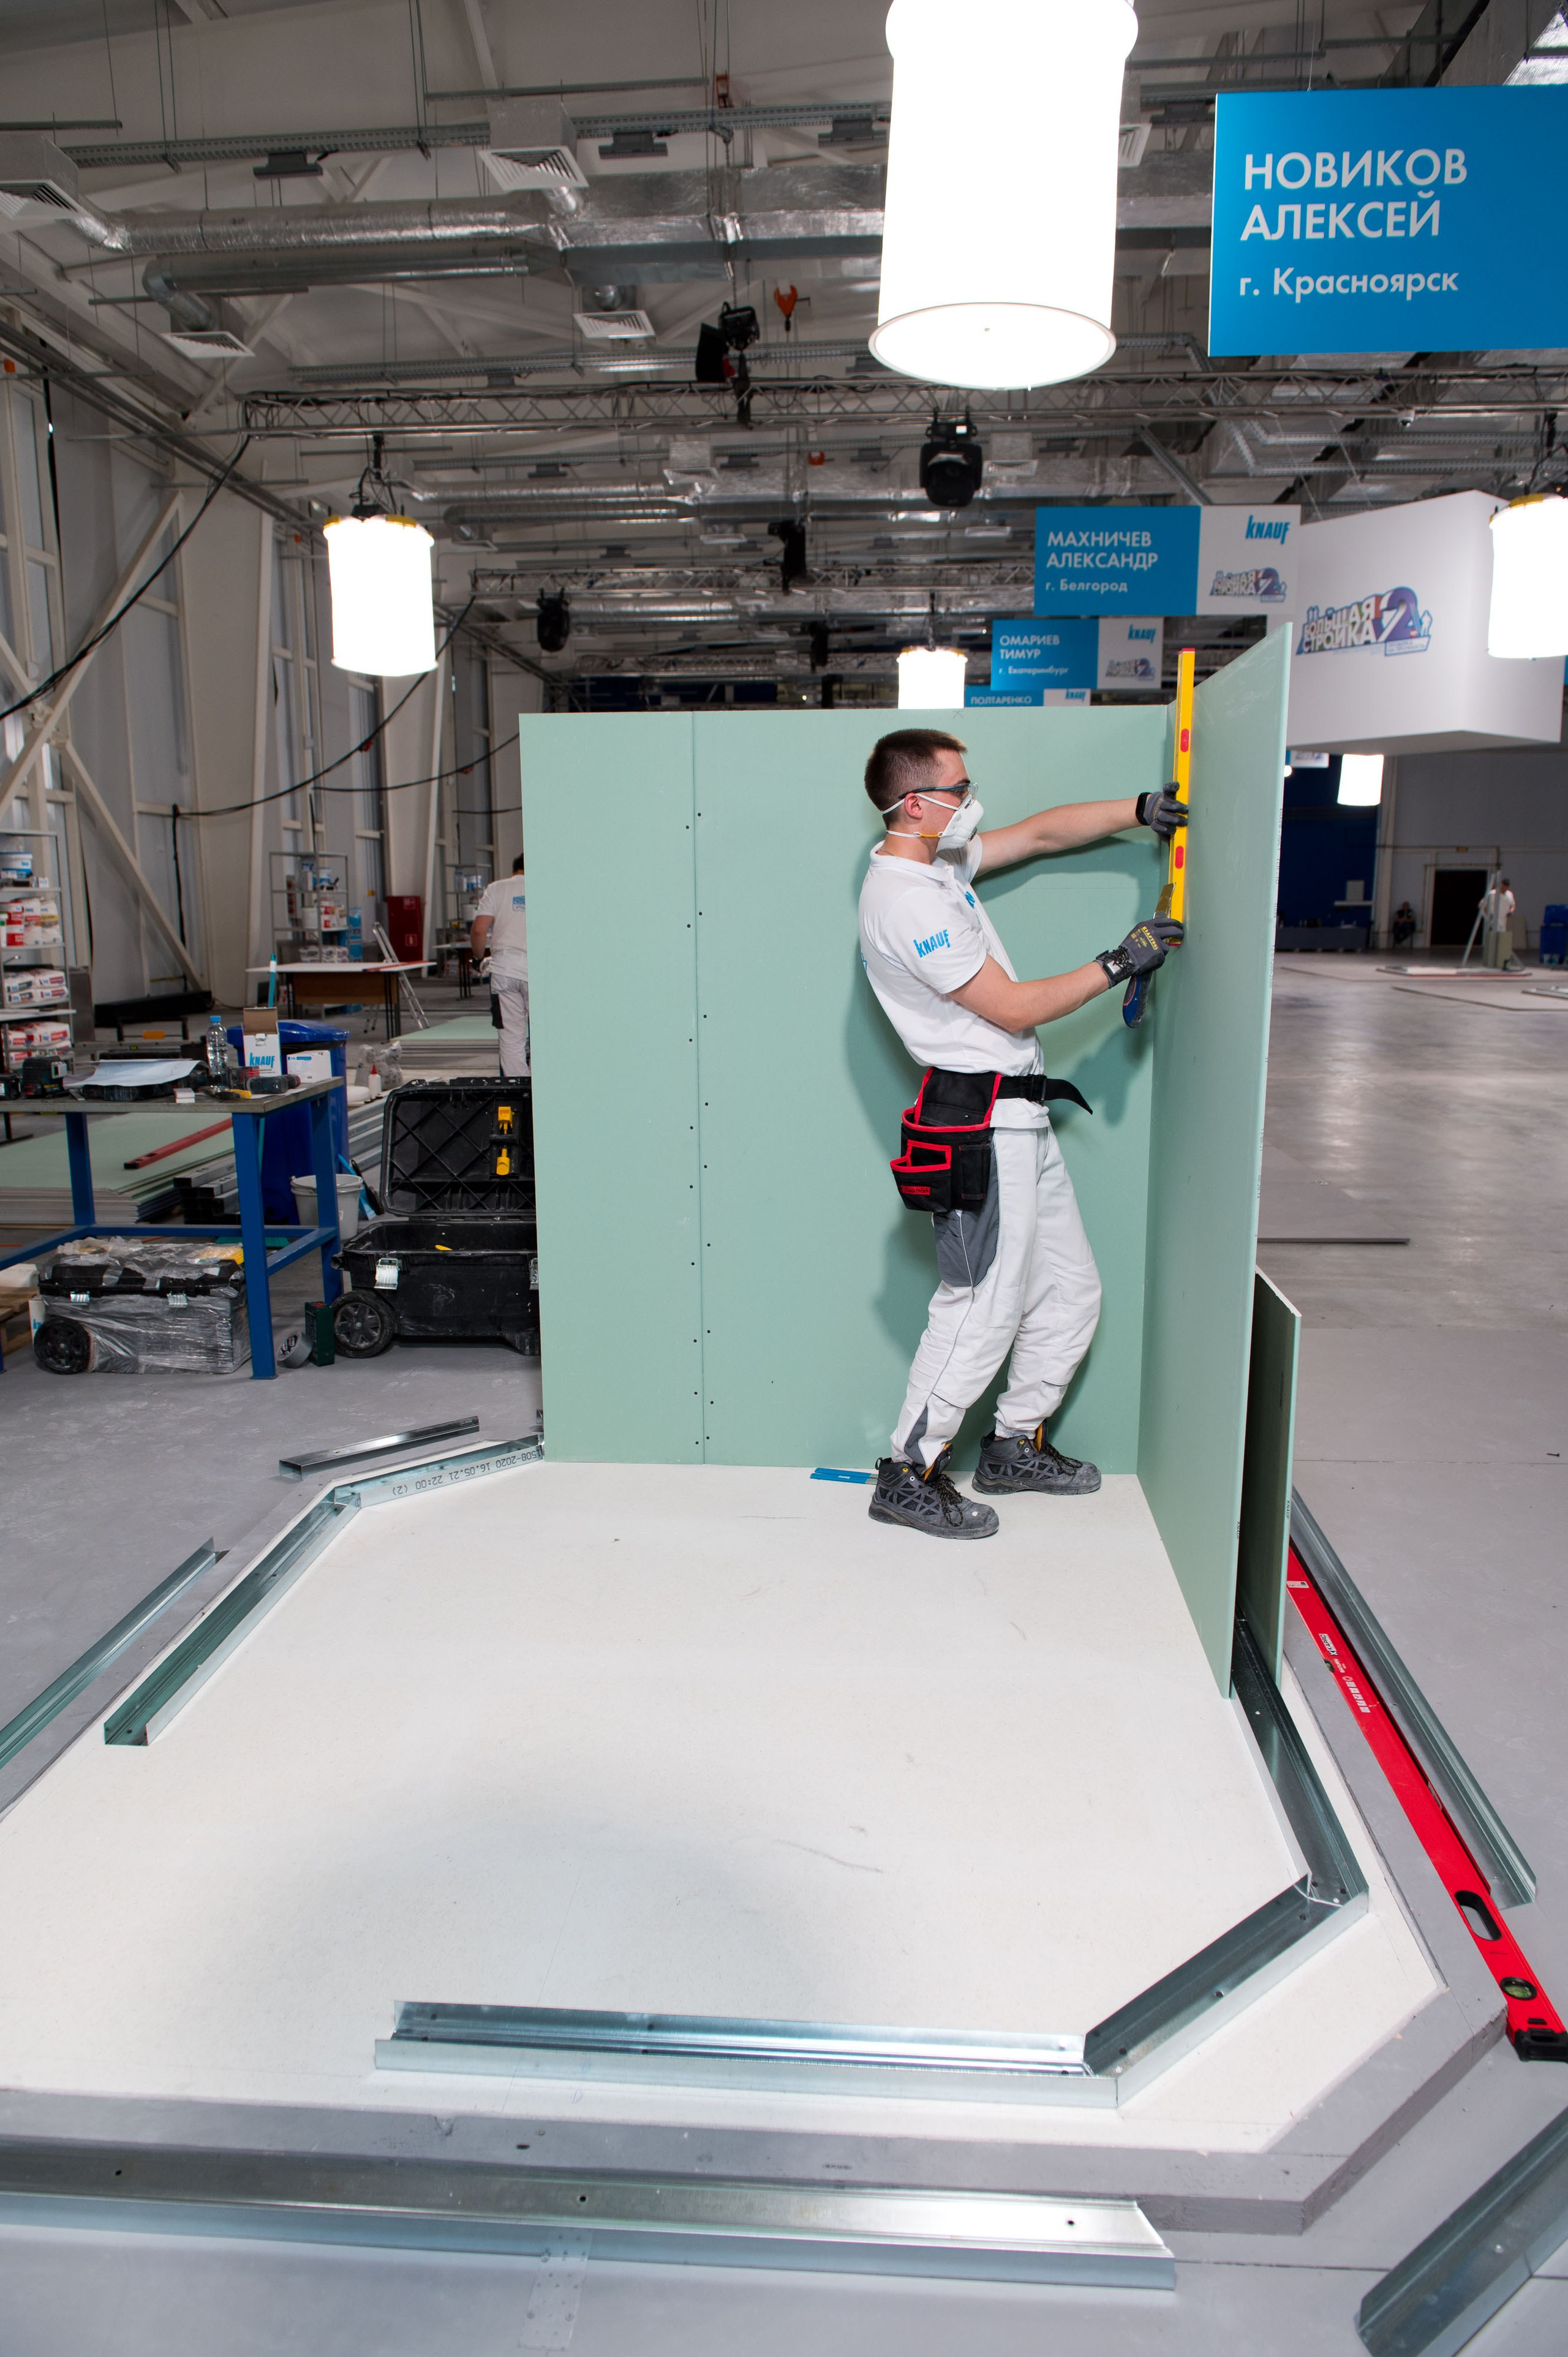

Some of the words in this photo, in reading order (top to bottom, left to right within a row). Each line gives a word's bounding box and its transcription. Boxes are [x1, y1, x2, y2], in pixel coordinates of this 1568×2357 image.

[1244, 148, 1468, 190] НОВИКОВ
[1239, 190, 1441, 241] АЛЕКСЕЙ
[1238, 276, 1261, 296] г.
[1273, 267, 1460, 304] Красноярск
[1245, 513, 1291, 545] KNAUF
[1047, 530, 1152, 547] МАХНИЧЕВ
[1046, 552, 1159, 571] АЛЕКСАНДР
[1045, 581, 1055, 591] г.
[1060, 578, 1128, 594] Белгород
[1000, 635, 1060, 646] ОМАРИЕВ
[1000, 649, 1041, 659] ТИМУР
[971, 695, 1032, 704] ПОЛТАРЕНКО
[913, 929, 951, 958] KNAUF
[249, 1052, 275, 1069] KNAUF
[449, 1461, 491, 1480] 16.05.21
[392, 1485, 409, 1496] (2)
[415, 1475, 443, 1490] 22:00
